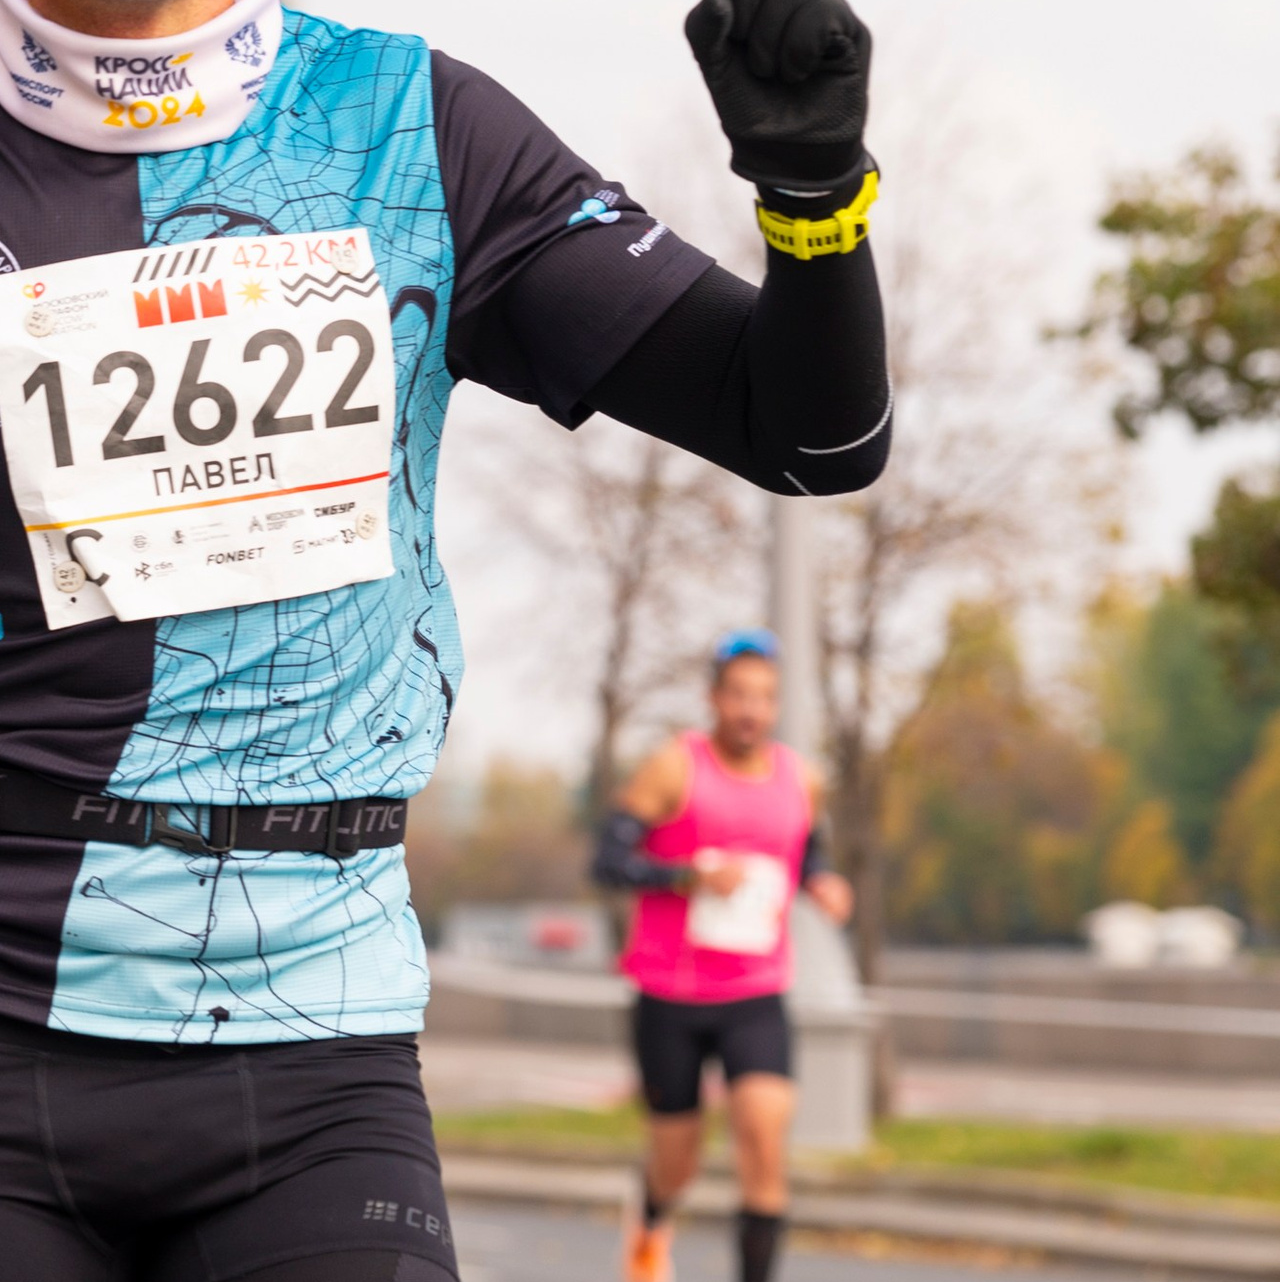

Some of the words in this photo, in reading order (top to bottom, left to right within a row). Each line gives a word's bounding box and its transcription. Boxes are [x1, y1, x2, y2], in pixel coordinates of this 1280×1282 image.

[94, 54, 174, 75] КРОСС
[95, 67, 193, 100] НАЦИИ
[102, 90, 207, 130] 2024
[232, 241, 298, 271] 42,2
[23, 319, 379, 468] 12622
[153, 453, 276, 496] ПАВЕЛ
[206, 547, 265, 566] FONBET
